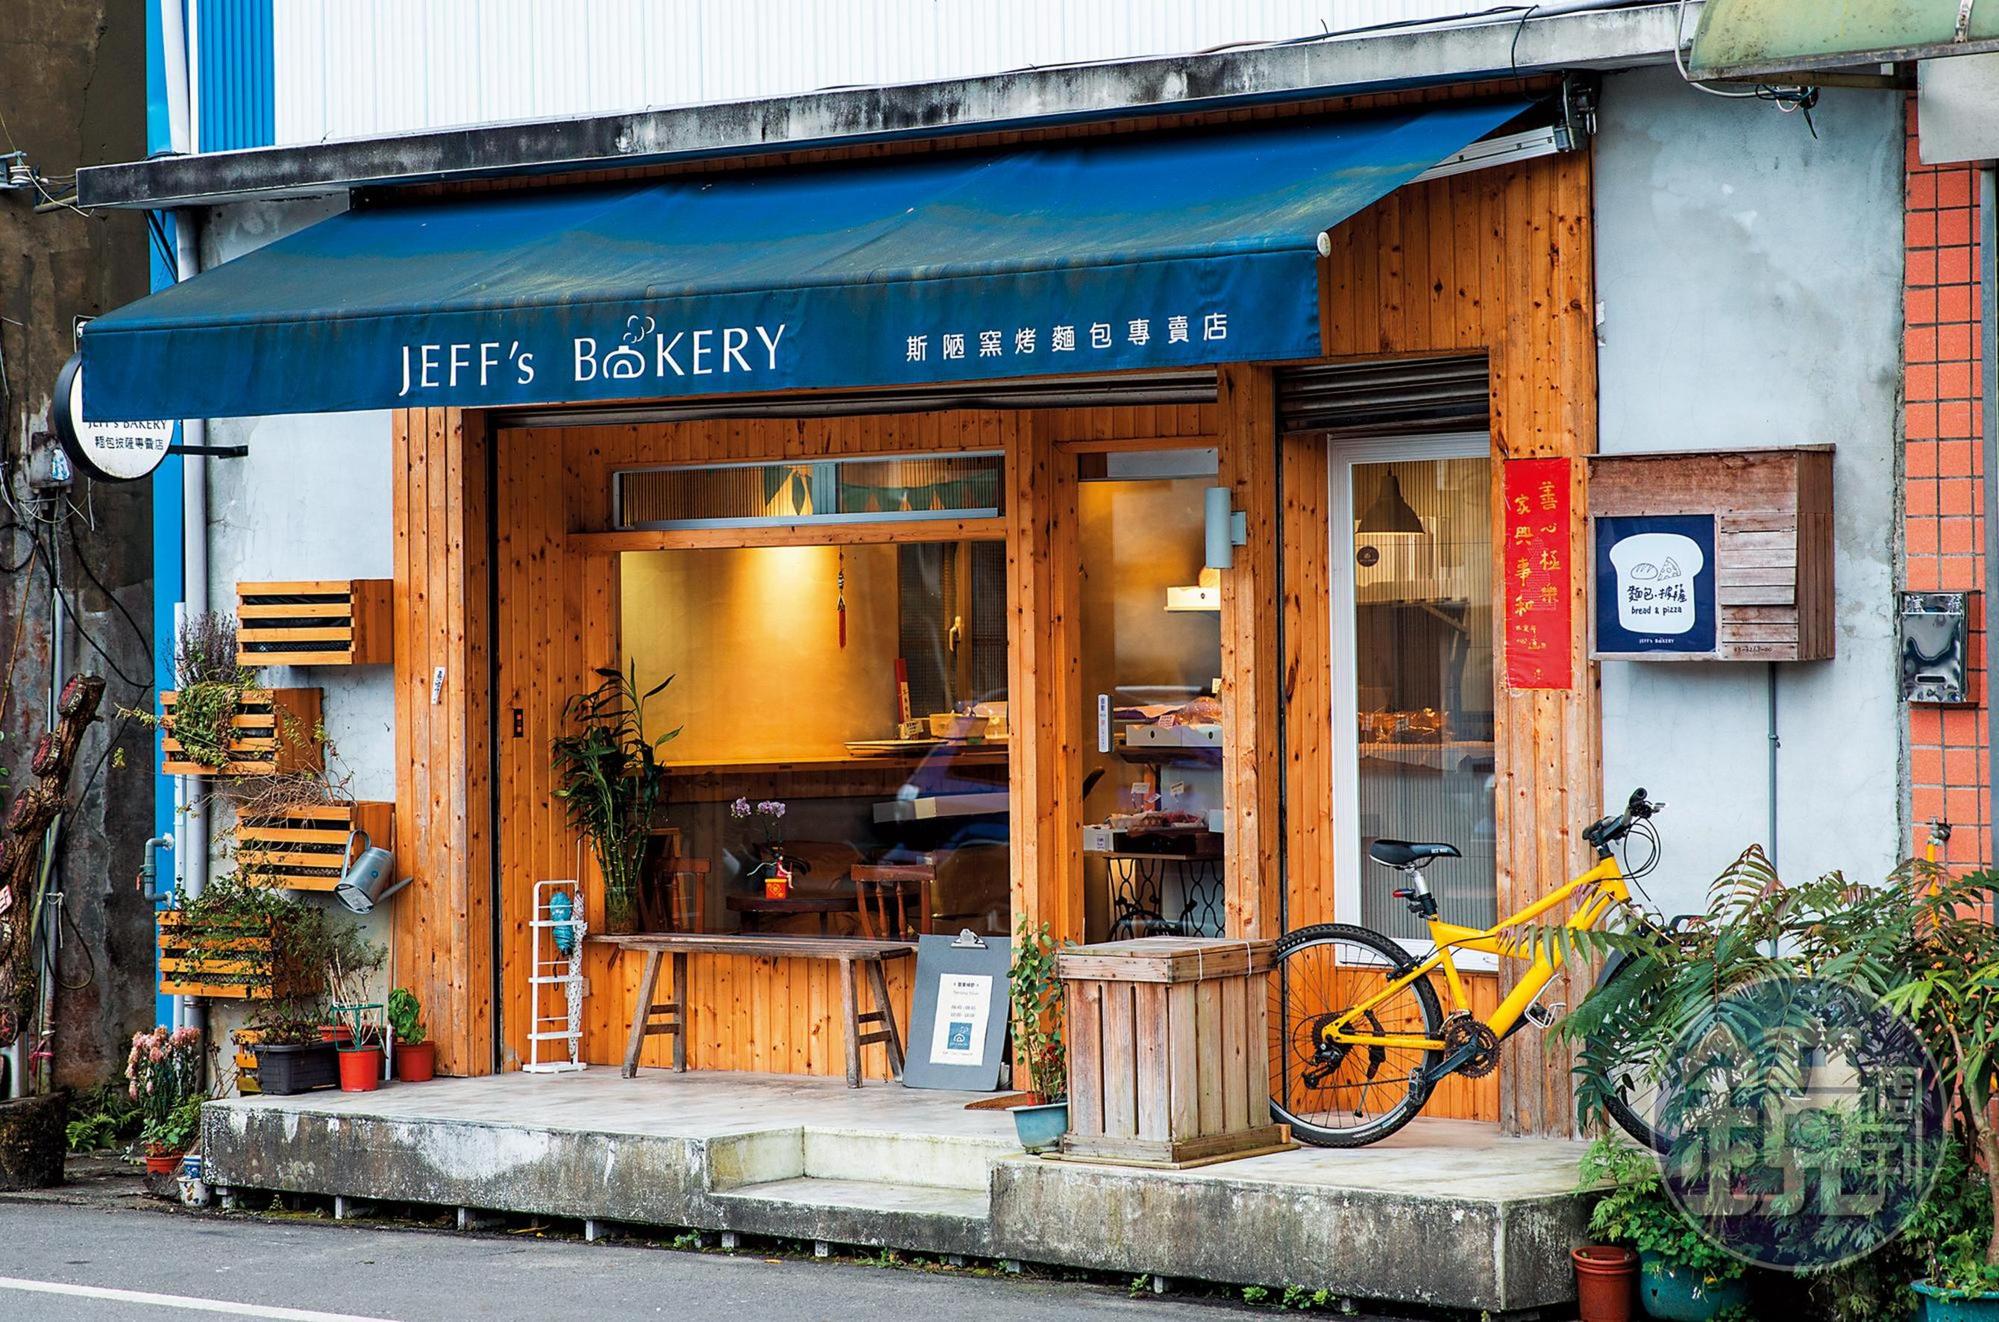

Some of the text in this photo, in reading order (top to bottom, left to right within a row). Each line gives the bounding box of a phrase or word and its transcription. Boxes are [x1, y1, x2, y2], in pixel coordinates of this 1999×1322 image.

[906, 312, 1229, 362] 斯陋窯烤麵包專賣店
[399, 340, 535, 396] JEFF's
[1631, 606, 1651, 615] bread
[1663, 606, 1682, 616] pizza
